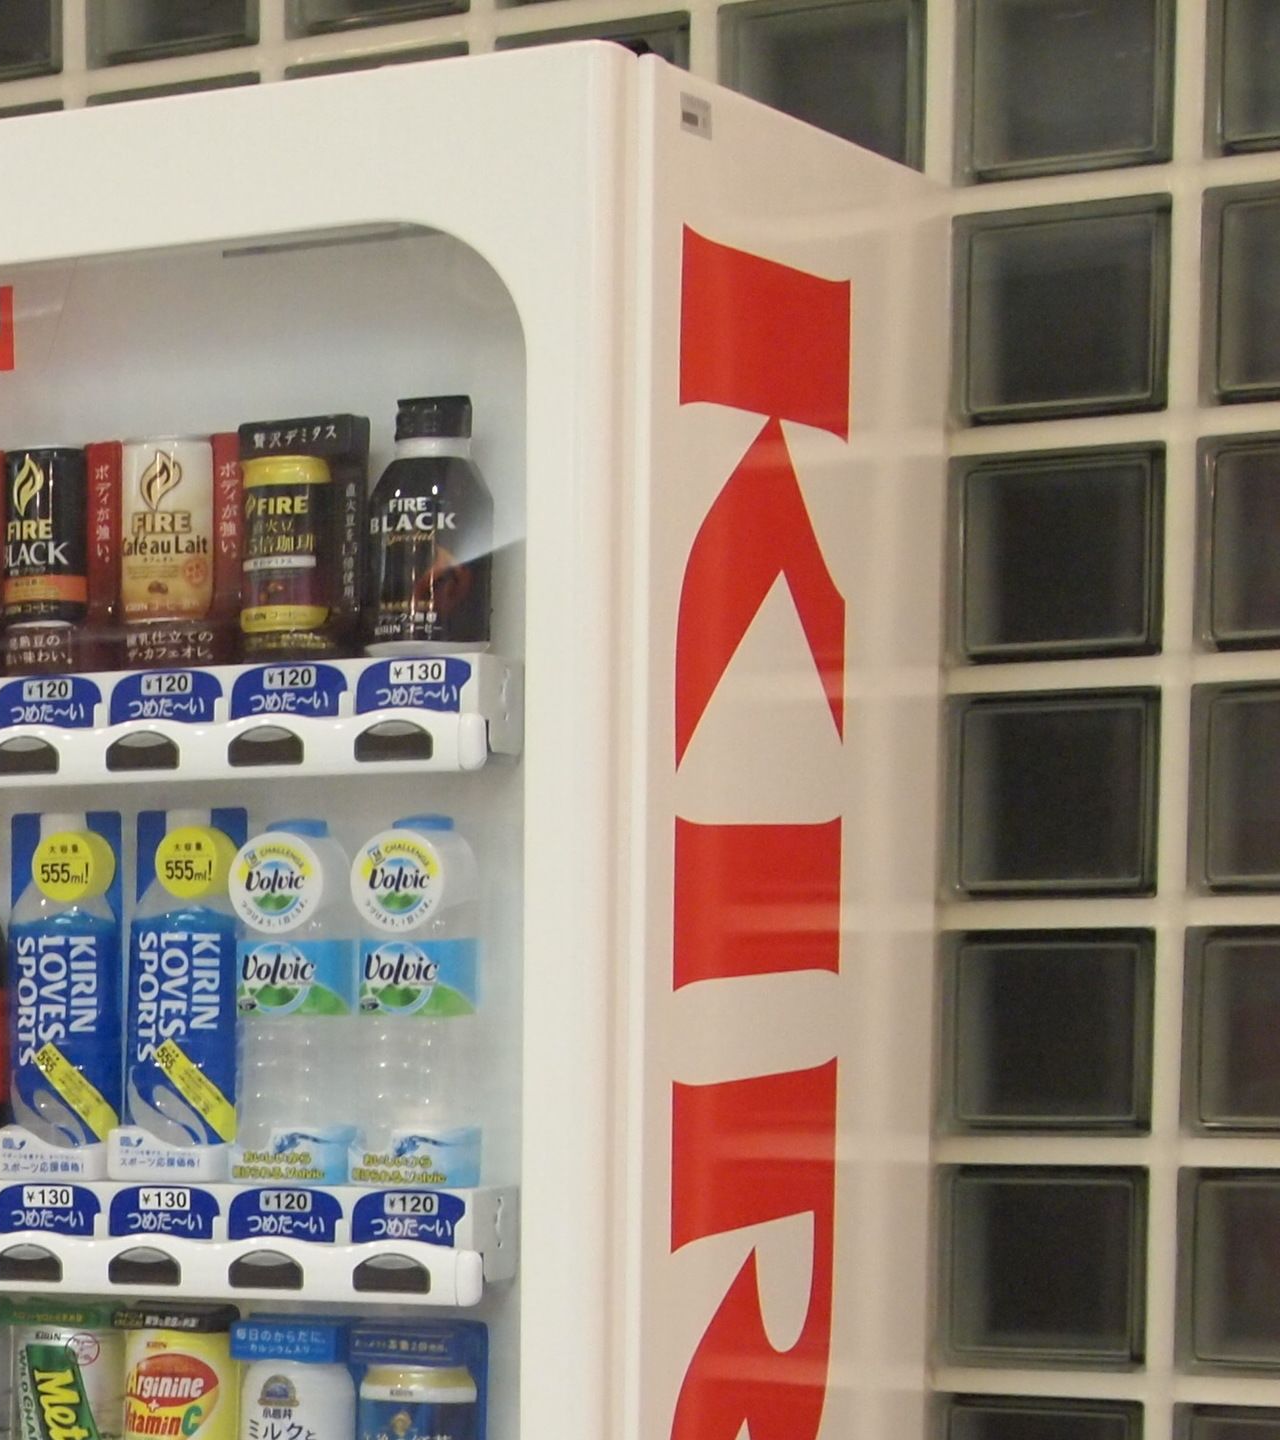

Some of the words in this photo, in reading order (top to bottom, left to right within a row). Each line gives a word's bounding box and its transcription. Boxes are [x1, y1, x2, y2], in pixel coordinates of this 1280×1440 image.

[257, 496, 309, 515] FIRE
[388, 496, 427, 513] FIRE
[7, 519, 52, 542] FIRE
[132, 512, 191, 534] FIRE
[370, 512, 456, 534] BLACK
[150, 540, 171, 555] au
[175, 536, 208, 555] Lait
[394, 662, 442, 681] ¥130
[27, 682, 69, 699] ¥120
[146, 675, 189, 693] ¥120
[245, 867, 304, 892] Volvic
[368, 866, 430, 892] Volvic
[242, 951, 315, 984] Volvic
[364, 950, 438, 983] Volvic
[39, 935, 68, 1043] LOVES
[69, 936, 97, 1033] KIRIN
[158, 932, 188, 1039] LOVES
[191, 932, 221, 1030] KIRIN
[16, 936, 37, 1066] SPORTS
[138, 932, 160, 1063] SPORTS
[26, 1188, 71, 1206] ¥130
[263, 1194, 309, 1210] ¥120
[389, 1196, 435, 1213] ¥120
[34, 1331, 62, 1341] KIRIN
[127, 1362, 204, 1398] Arginine
[249, 1419, 317, 1440] ミルクと
